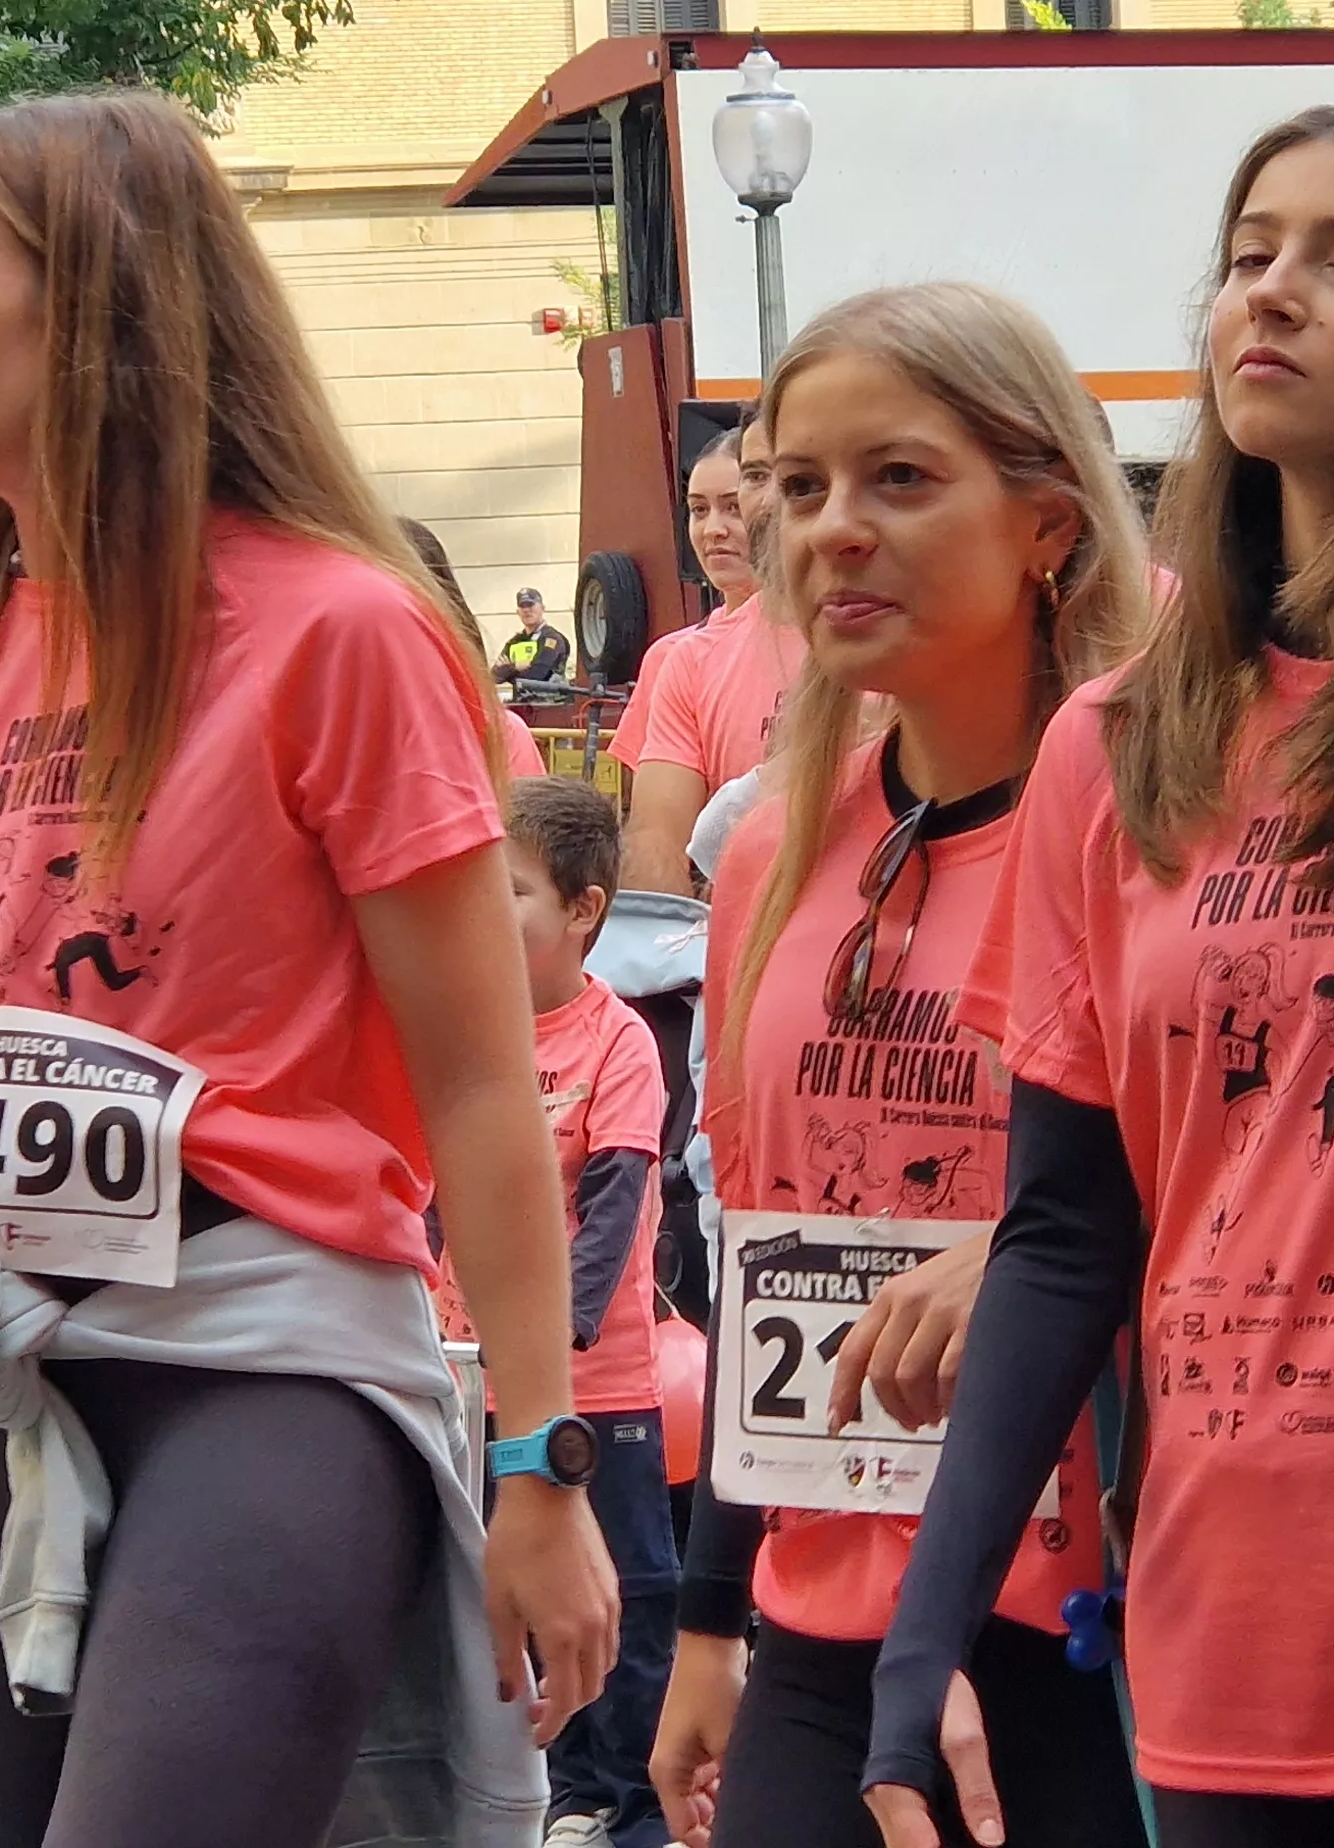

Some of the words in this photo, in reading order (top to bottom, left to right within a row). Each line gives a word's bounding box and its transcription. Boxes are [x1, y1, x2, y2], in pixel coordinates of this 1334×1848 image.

[1191, 870, 1254, 930] POR
[1252, 864, 1291, 921] LA
[10, 1057, 40, 1083] EL
[45, 1057, 160, 1095] CÁNCER
[795, 1041, 844, 1096] POR
[847, 1043, 875, 1099] LA
[881, 1045, 979, 1107] CIENCIA
[840, 1249, 919, 1273] HUESCA
[756, 1269, 864, 1301] CONTRA
